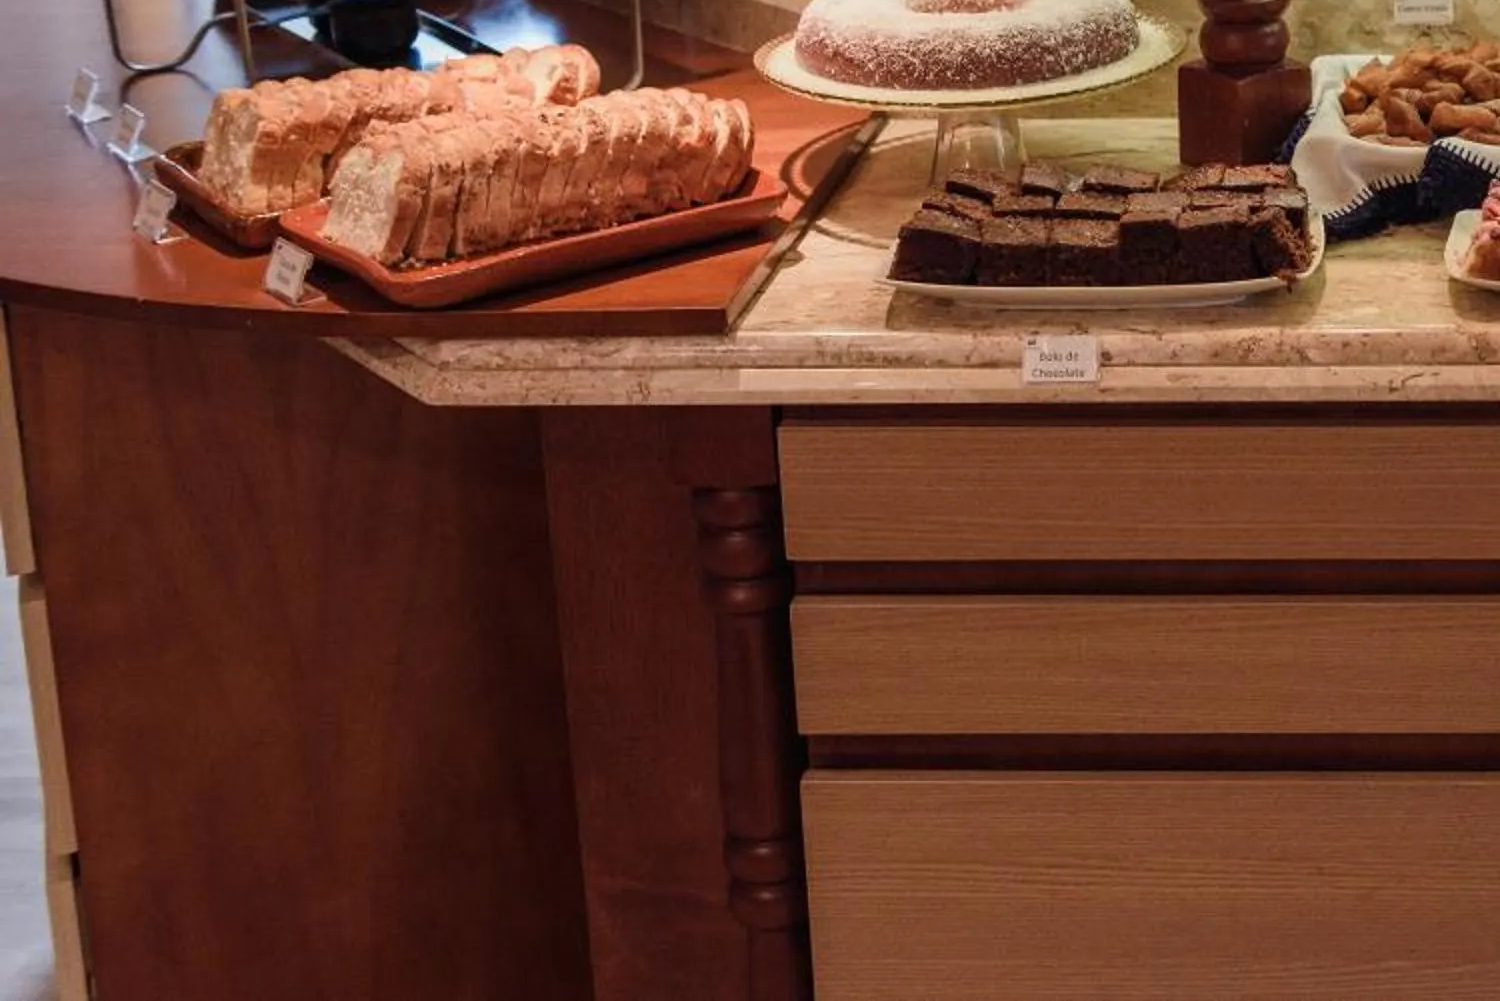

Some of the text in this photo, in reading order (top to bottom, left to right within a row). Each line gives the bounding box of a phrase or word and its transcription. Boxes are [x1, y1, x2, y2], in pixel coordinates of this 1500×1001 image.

[1040, 350, 1079, 361] Bolo de
[1031, 367, 1085, 378] Chocolate
